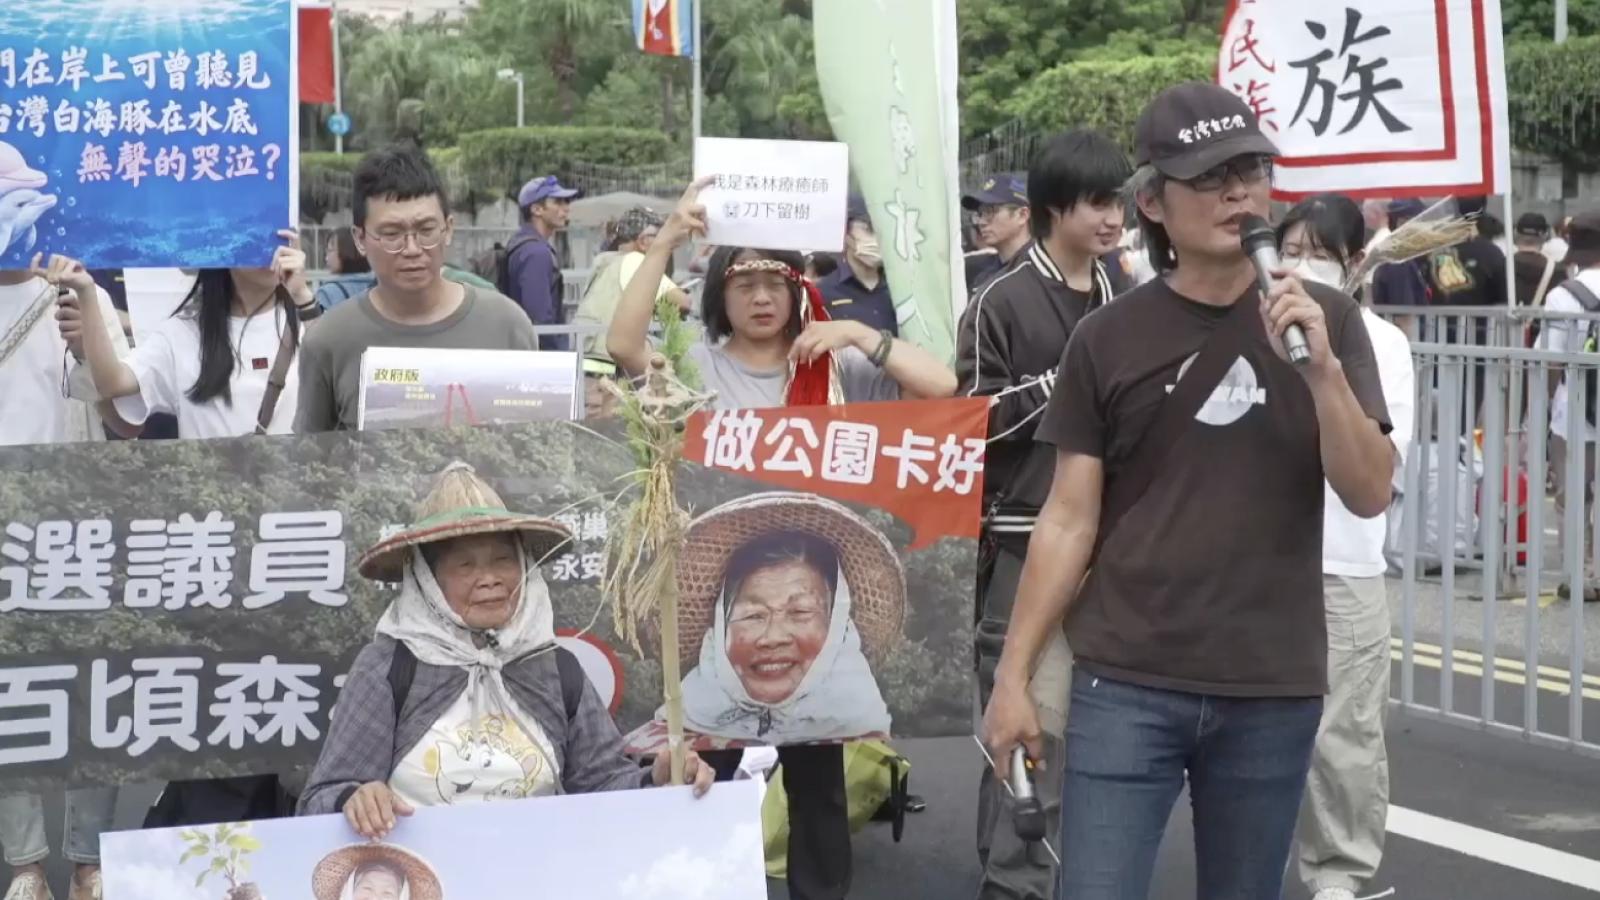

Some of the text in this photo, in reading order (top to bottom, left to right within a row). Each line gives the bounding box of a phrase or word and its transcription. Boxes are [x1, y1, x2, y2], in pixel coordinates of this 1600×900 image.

[1228, 0, 1276, 132] 民族
[1287, 7, 1413, 138] 族
[76, 141, 281, 187] 無聲的哭泣?
[713, 173, 829, 193] 我是森林療癒師
[743, 202, 810, 220] 刀下留樹
[373, 368, 420, 382] 政府版
[702, 408, 986, 495] 做公園卡好
[0, 510, 348, 612] 選議員
[553, 552, 607, 580] 永安
[0, 655, 348, 765] 百頃森
